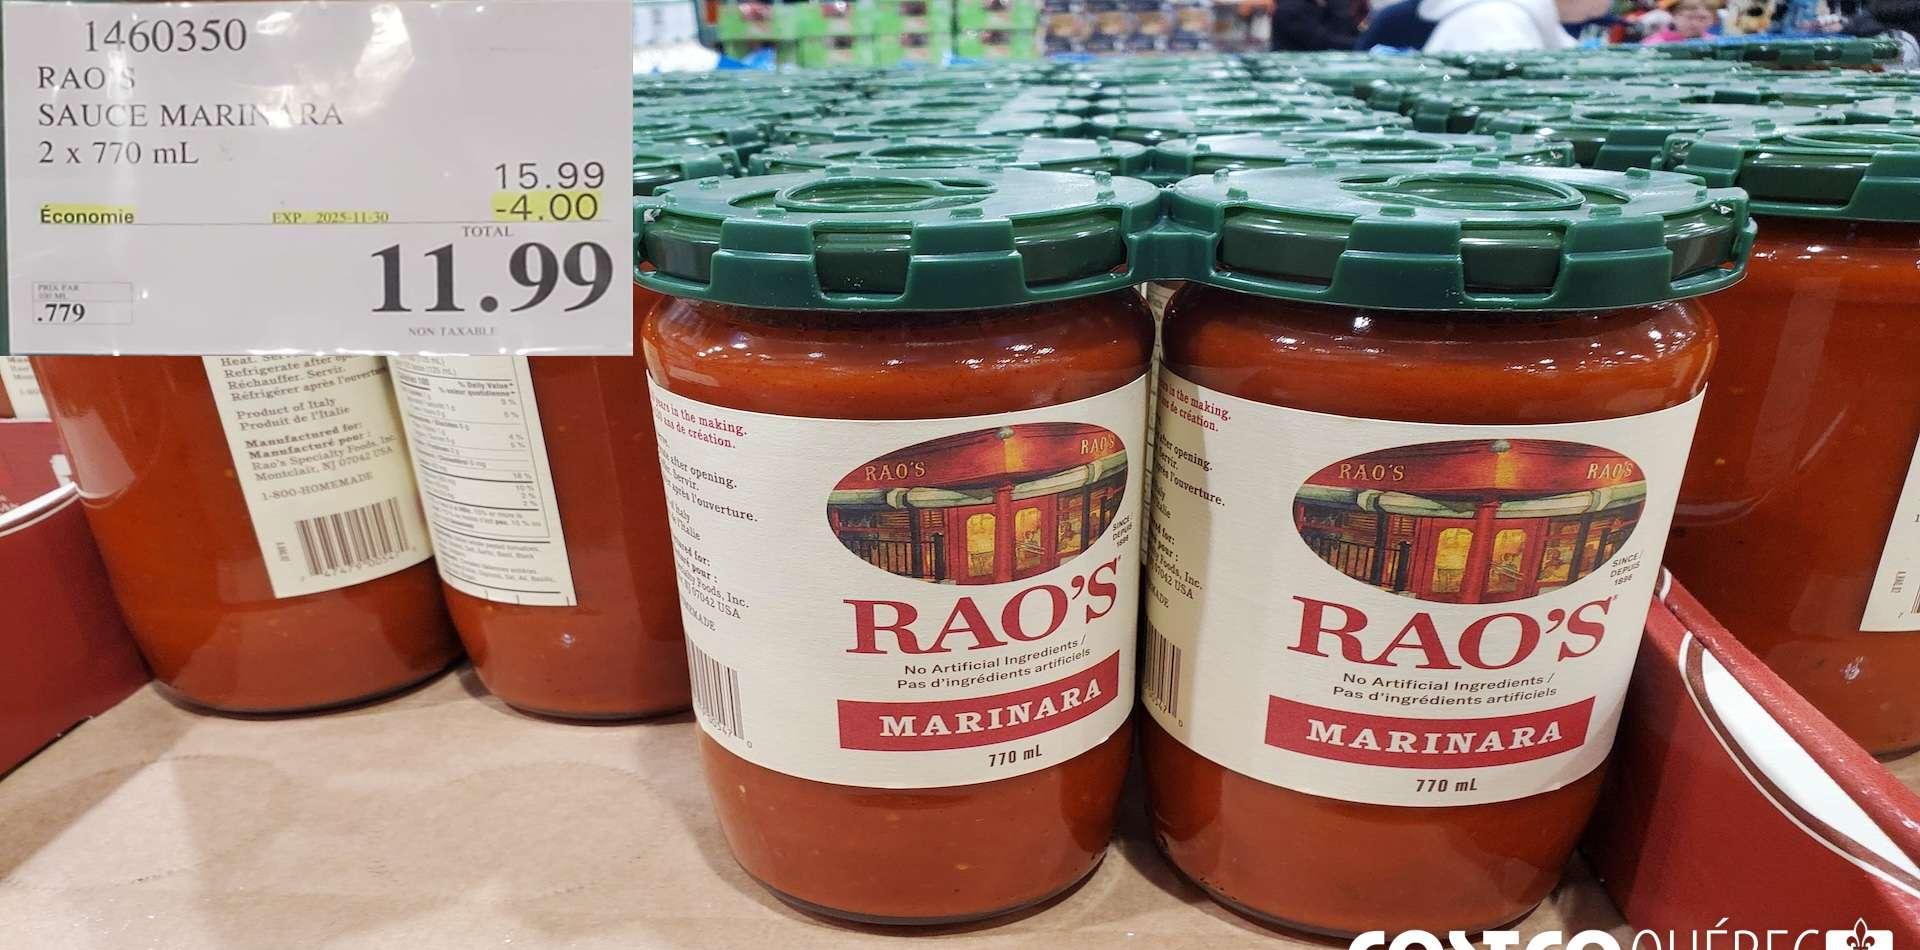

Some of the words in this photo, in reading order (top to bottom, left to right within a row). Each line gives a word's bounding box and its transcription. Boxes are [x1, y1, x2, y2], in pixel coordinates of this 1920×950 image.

[85, 18, 247, 52] 1460350
[37, 66, 136, 90] RAOS
[38, 104, 148, 127] SAUCE
[40, 142, 54, 163] 2
[66, 147, 81, 163] x
[94, 142, 142, 164] 770
[153, 142, 200, 164] mL
[494, 162, 604, 190] 15.99
[40, 205, 134, 224] Économie
[316, 212, 390, 224] 2025-11-30
[496, 194, 598, 222] -4.00
[462, 226, 514, 238] TOTAL
[371, 242, 614, 312] 11.99
[38, 303, 86, 322] .779
[408, 327, 435, 336] NON
[224, 362, 300, 378] Refrigerate
[236, 406, 288, 420] Product
[292, 402, 304, 412] of
[308, 397, 336, 410] Italy
[1170, 401, 1178, 415] de
[1180, 410, 1218, 432] création.
[1176, 388, 1189, 404] the
[1190, 400, 1232, 422] making.
[240, 417, 289, 432] Produit
[293, 414, 308, 424] de
[311, 406, 350, 422] l'Italie
[672, 406, 679, 416] in
[680, 408, 696, 422] the
[698, 416, 748, 437] making.
[245, 427, 339, 449] Manufactured
[342, 422, 362, 434] for:
[676, 421, 686, 434] de
[688, 428, 736, 448] création.
[249, 439, 334, 460] Manufacturé
[252, 459, 286, 472] Rao's
[290, 448, 345, 466] Specialty
[323, 462, 337, 473] NJ
[339, 452, 372, 467] 07042
[375, 446, 393, 458] USA
[1174, 445, 1213, 472] opening.
[690, 466, 738, 490] opening.
[864, 461, 926, 480] RAO'S
[1338, 463, 1406, 481] RAO'S
[1586, 460, 1634, 480] RAO'S
[262, 472, 374, 501] 1-800-HOMEMADE
[1170, 470, 1226, 506] l'ouverture.
[692, 492, 758, 522] l'ouverture.
[691, 562, 712, 580] pour
[694, 550, 711, 568] for:
[696, 577, 724, 602] Foods,
[726, 592, 750, 608] Inc.
[1174, 580, 1194, 600] USA
[1184, 572, 1202, 590] Inc.
[717, 600, 742, 620] USA
[844, 558, 1118, 655] RAO'S
[1286, 595, 1612, 670] RAO'S
[898, 679, 926, 689] Pas
[930, 666, 1031, 690] d'ingrédients
[1034, 647, 1092, 673] artificiels
[904, 664, 927, 675] No
[932, 658, 1000, 674] Artificial
[1004, 638, 1078, 667] Ingredients
[1343, 672, 1366, 686] No
[1372, 676, 1449, 691] Artificial
[1454, 674, 1544, 692] Ingredients
[878, 678, 1102, 737] MARINARA
[1332, 686, 1364, 700] Pas
[1368, 690, 1482, 706] d'ingrédients
[1486, 686, 1557, 705] artificiels
[1306, 718, 1562, 754] MARINARA
[988, 752, 1016, 768] 770
[1024, 744, 1042, 760] mL
[1415, 779, 1448, 794] 770
[1454, 778, 1478, 792] mL
